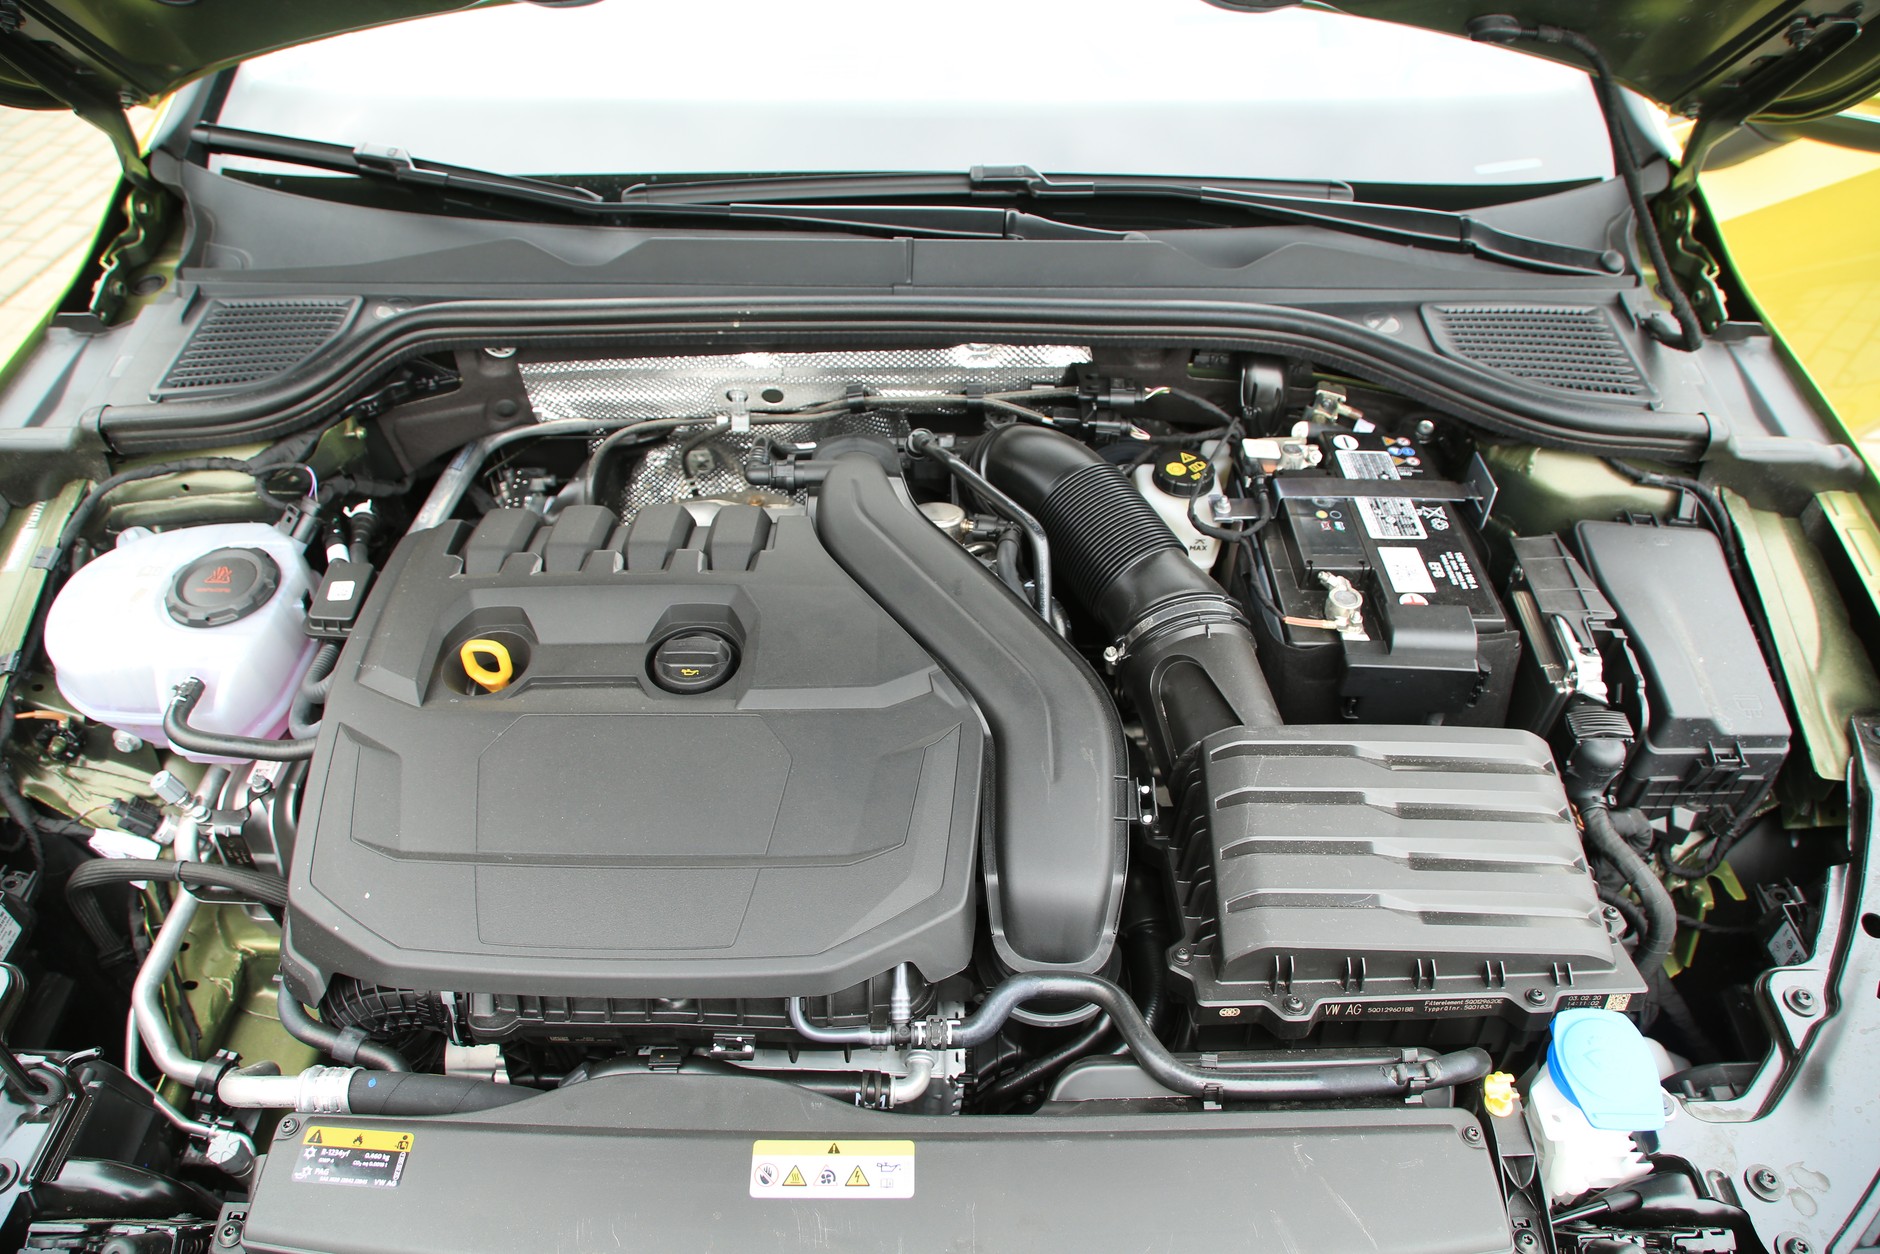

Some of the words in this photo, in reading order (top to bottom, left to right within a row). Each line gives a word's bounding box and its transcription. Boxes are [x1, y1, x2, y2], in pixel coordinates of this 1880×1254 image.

[1428, 562, 1445, 578] EFB
[1324, 1004, 1340, 1015] VW
[1345, 1004, 1362, 1015] AG
